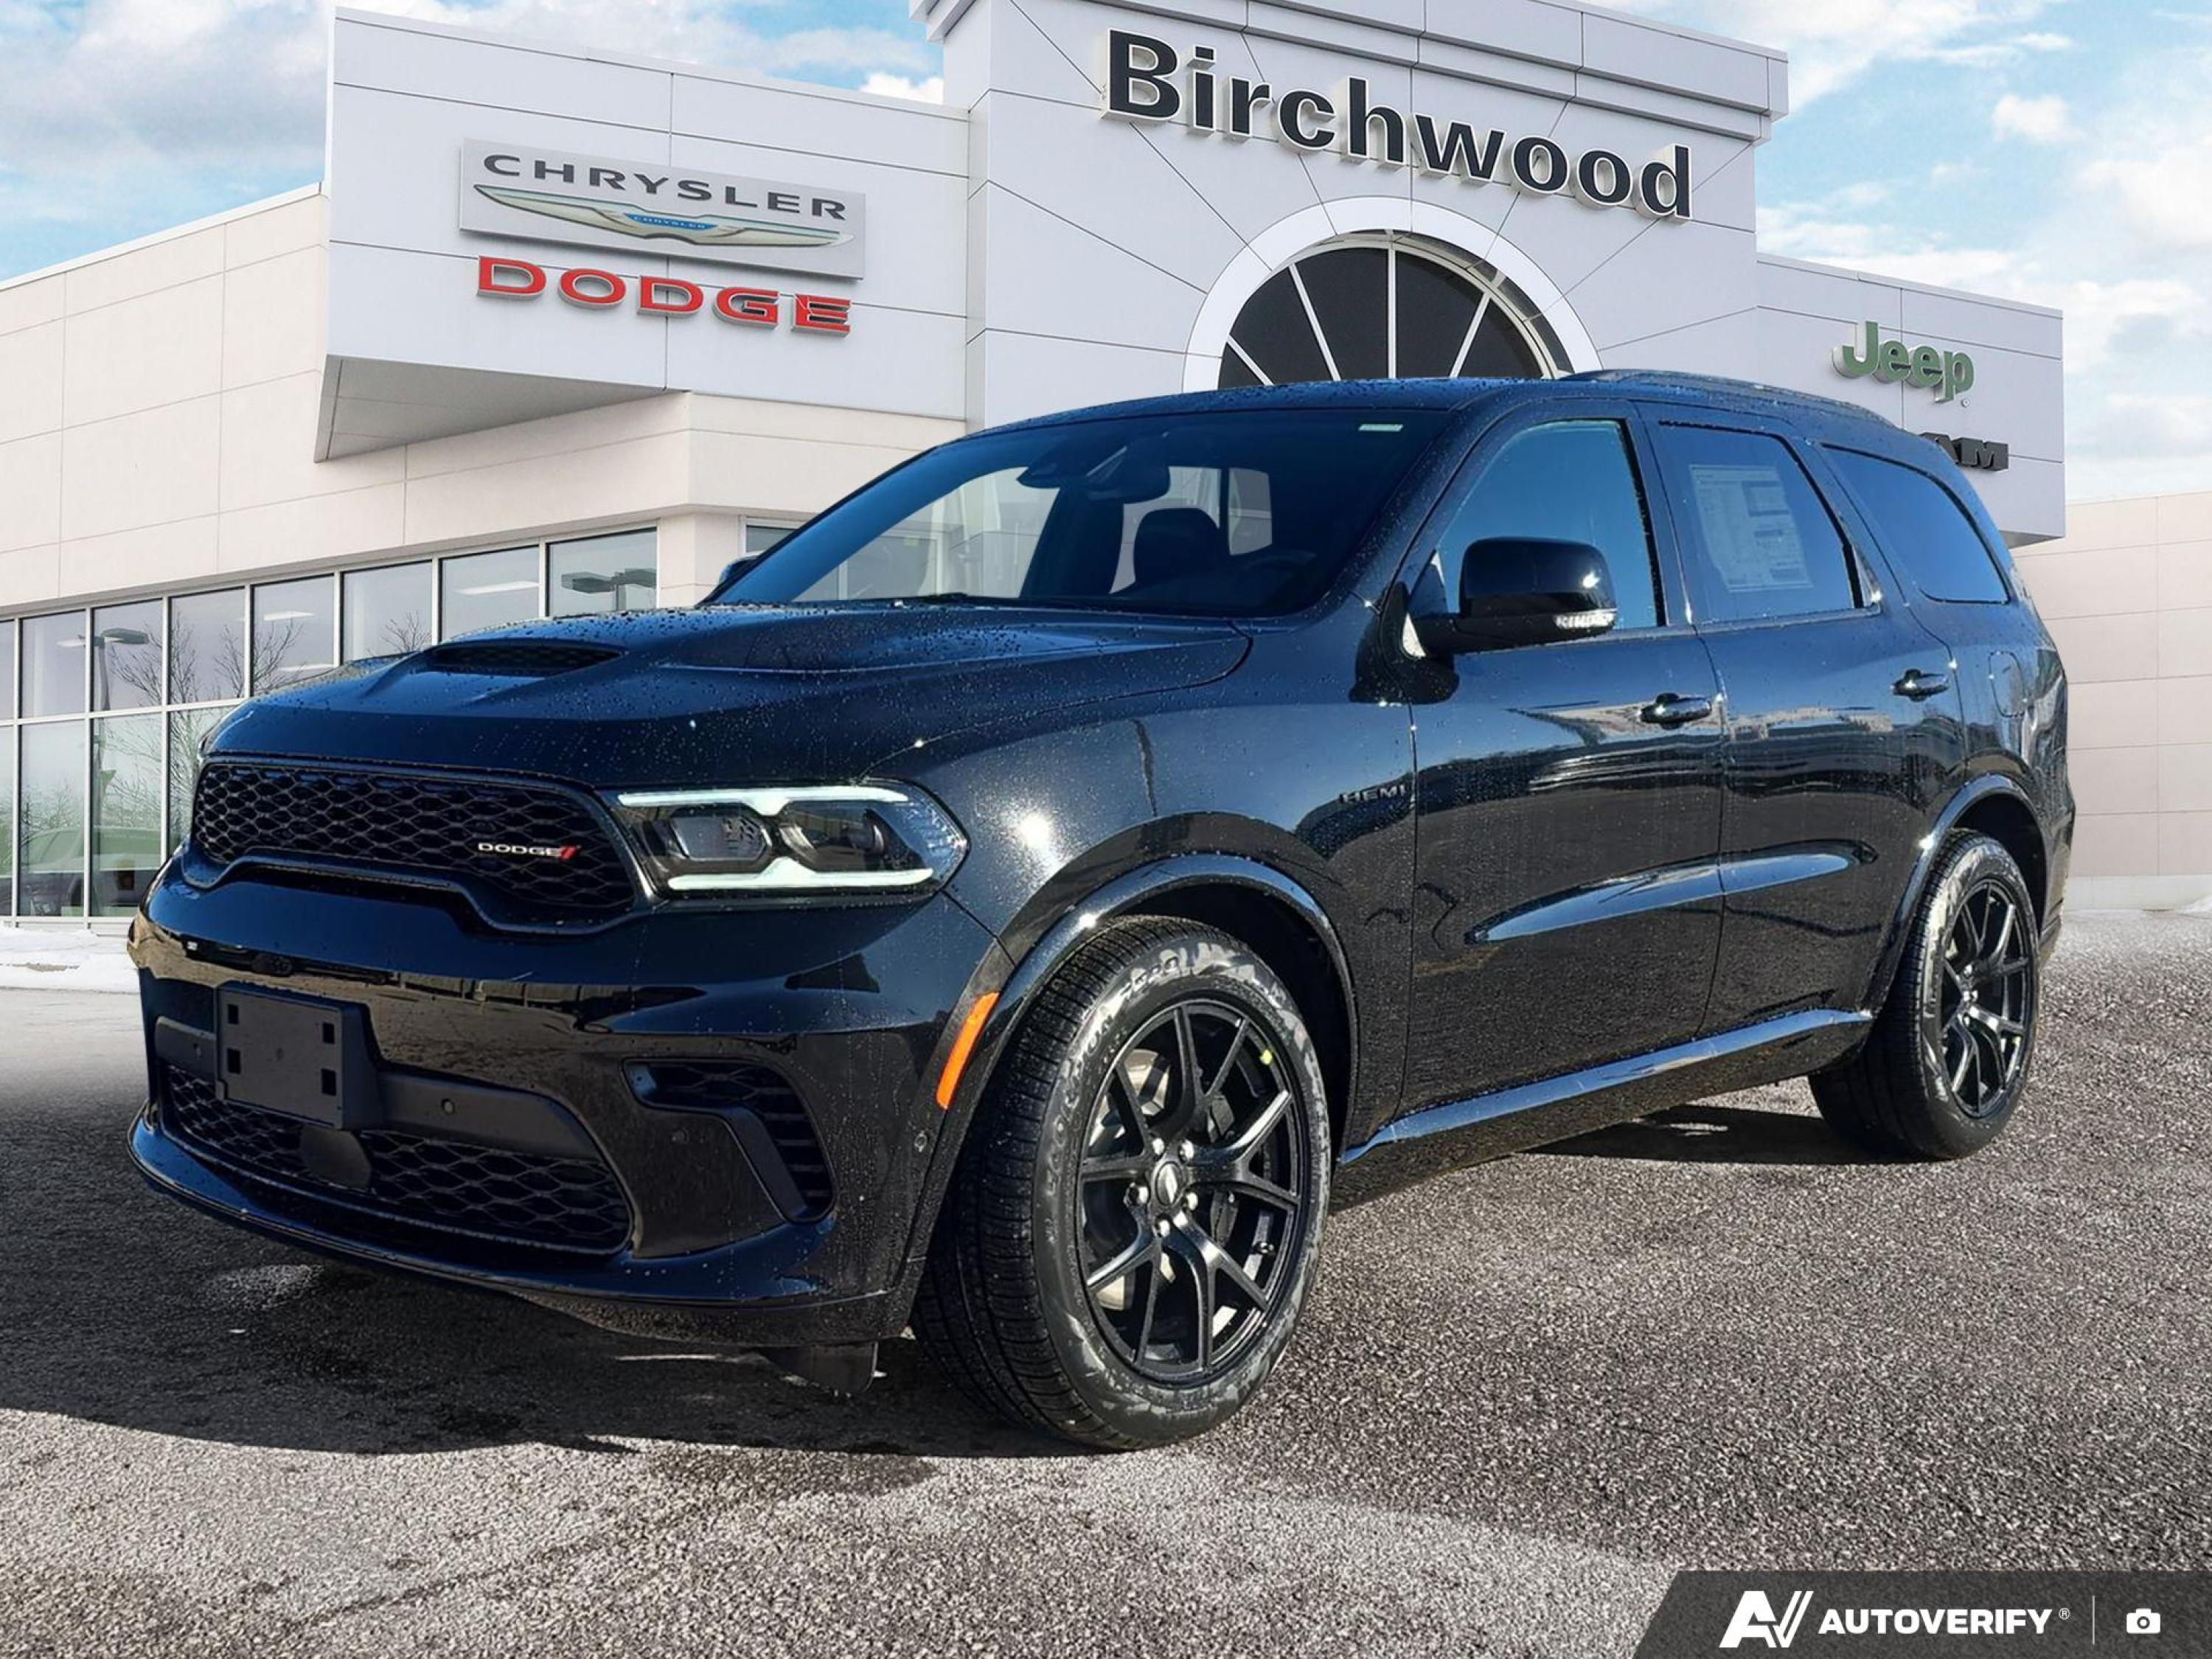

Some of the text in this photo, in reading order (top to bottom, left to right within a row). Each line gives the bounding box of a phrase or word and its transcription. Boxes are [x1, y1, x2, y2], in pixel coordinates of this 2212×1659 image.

[1103, 28, 1693, 221] Birchwood
[483, 154, 846, 220] CHRYSLER
[477, 255, 852, 336] DODGE
[1833, 320, 1975, 403] Jeep
[1340, 785, 1405, 803] HEMI
[478, 843, 562, 858] DODGE
